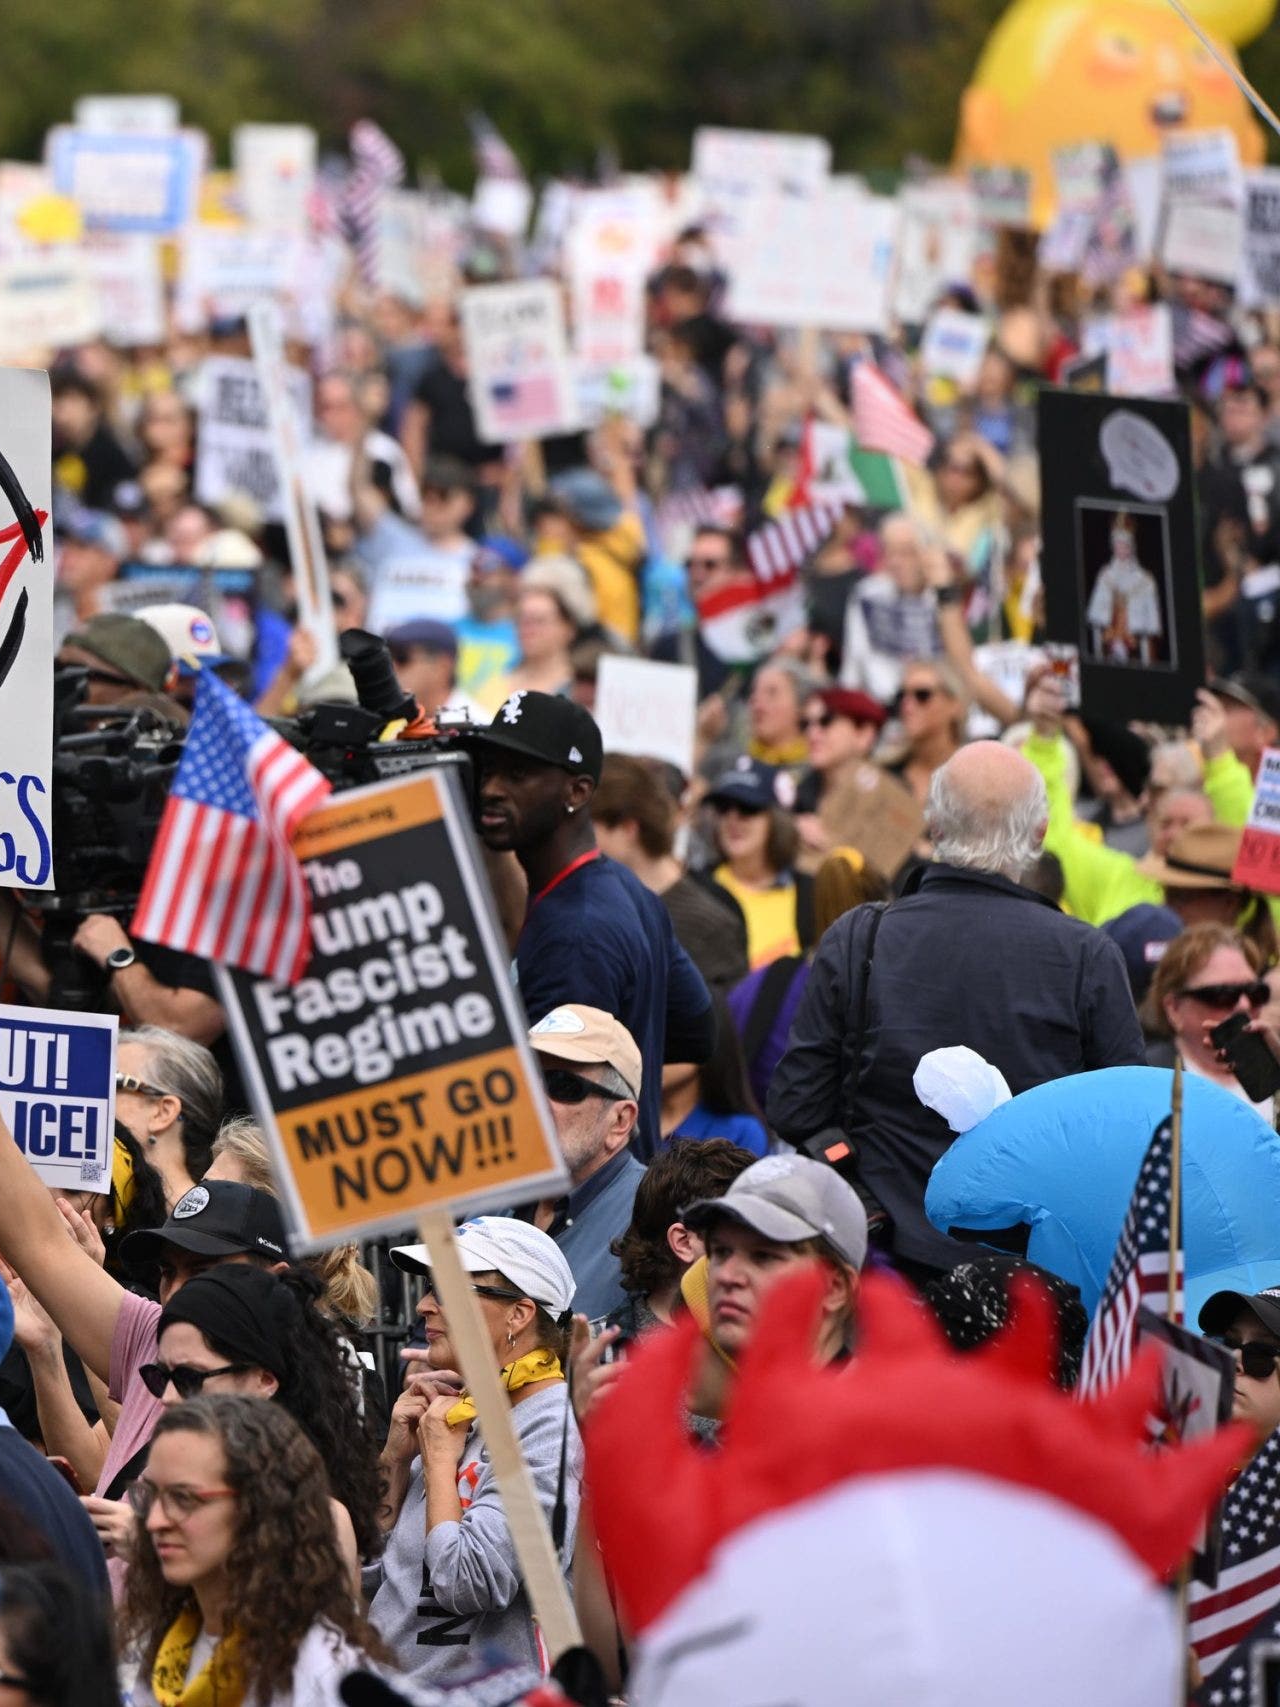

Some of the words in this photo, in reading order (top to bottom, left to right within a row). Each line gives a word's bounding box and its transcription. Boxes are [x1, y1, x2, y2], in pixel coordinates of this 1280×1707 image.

[309, 881, 445, 956] ump
[252, 925, 477, 1034] Fascist
[265, 992, 497, 1092] Regime
[13, 1100, 98, 1160] ICE!
[294, 1090, 428, 1163] MUST
[447, 1067, 518, 1116] GO
[331, 1115, 518, 1209] NOW!!!
